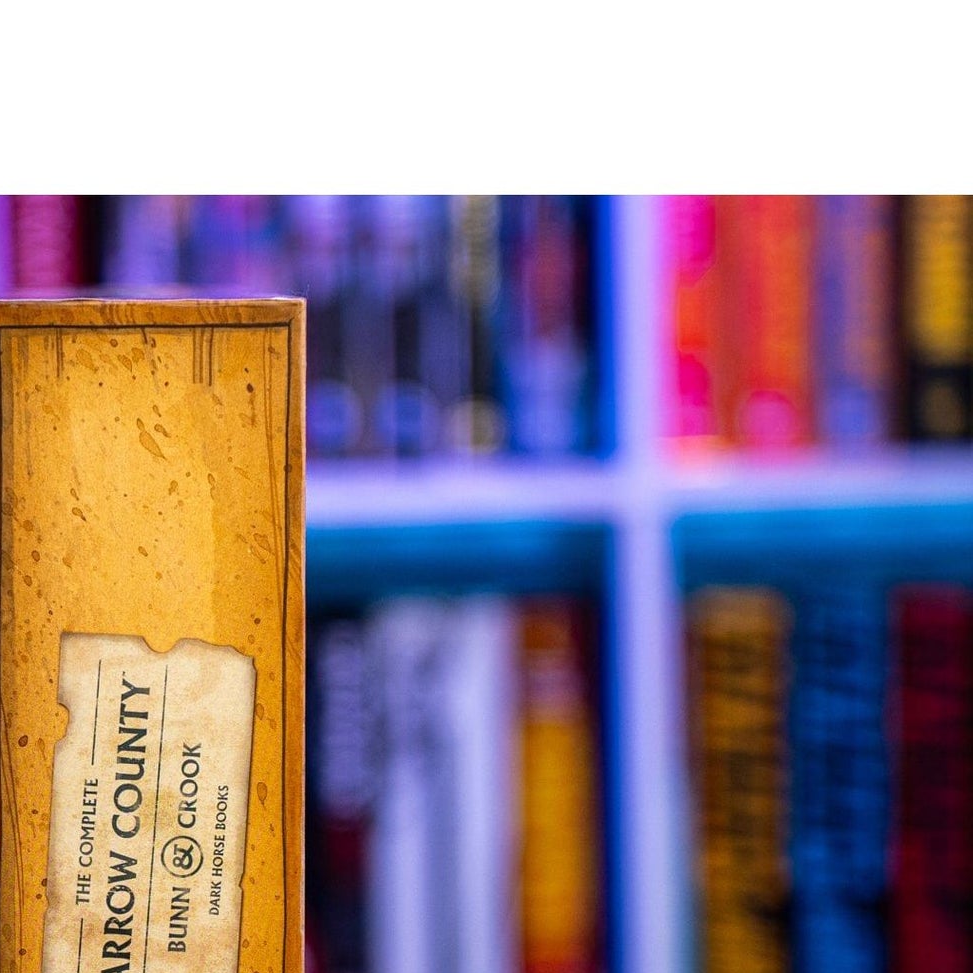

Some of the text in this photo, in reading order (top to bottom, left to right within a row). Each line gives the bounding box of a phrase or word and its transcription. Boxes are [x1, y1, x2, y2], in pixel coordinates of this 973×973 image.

[112, 678, 151, 839] COUNTY
[76, 778, 99, 905] THE COMPLETE
[167, 742, 202, 953] BUNN & CROOK
[209, 784, 229, 916] DARK HORSE BOOKS
